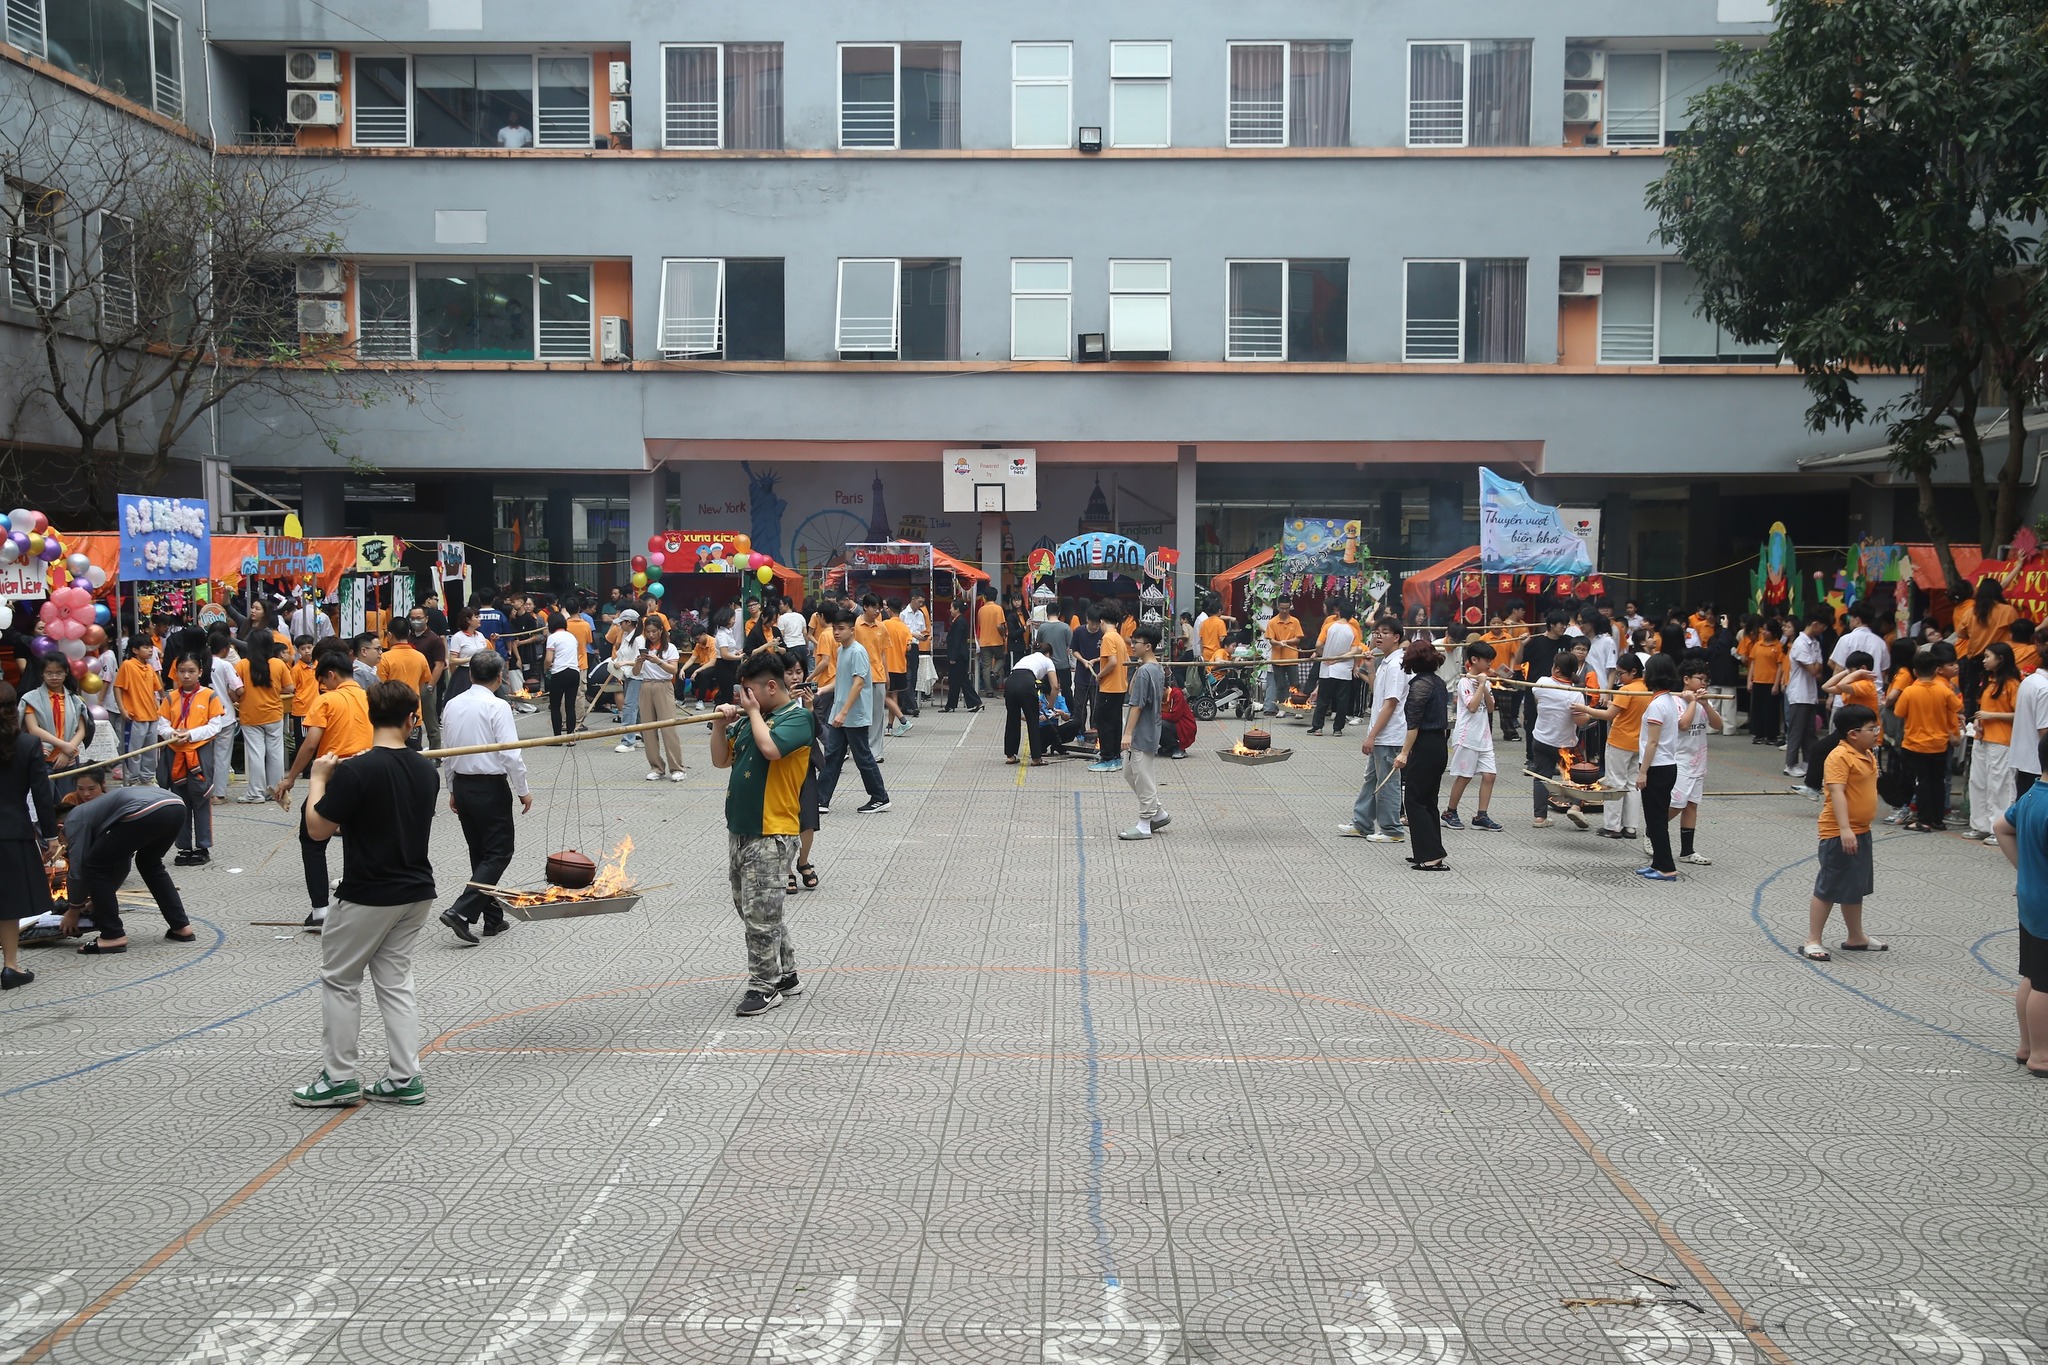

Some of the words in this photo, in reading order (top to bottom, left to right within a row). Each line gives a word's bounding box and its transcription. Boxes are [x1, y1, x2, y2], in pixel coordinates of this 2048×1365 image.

[835, 490, 864, 505] Paris
[698, 503, 722, 515] New
[724, 500, 747, 513] York
[683, 534, 711, 543] XUNG
[1104, 539, 1139, 572] BÃO
